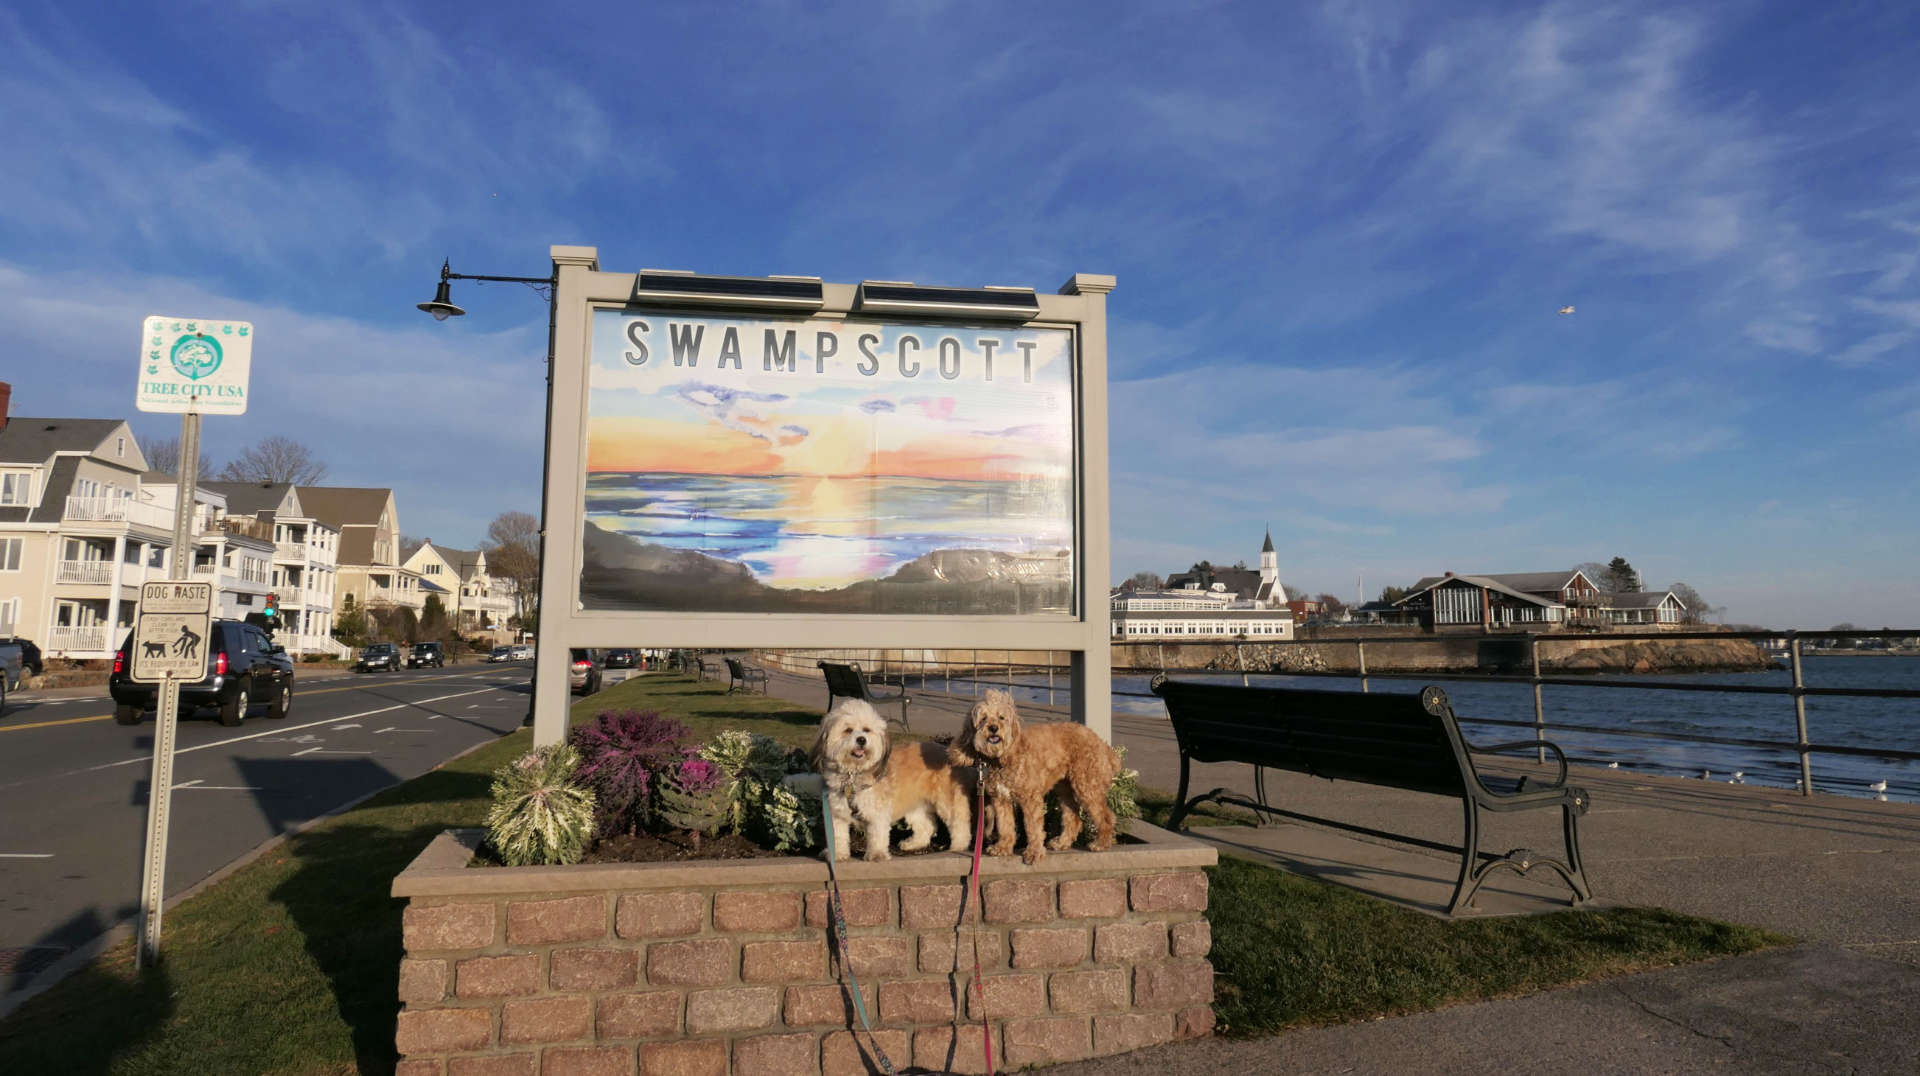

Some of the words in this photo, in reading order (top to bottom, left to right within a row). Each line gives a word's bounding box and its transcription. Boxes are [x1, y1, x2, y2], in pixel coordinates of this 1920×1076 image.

[625, 320, 1037, 383] SWAMPSCOTT
[142, 382, 179, 395] TREE
[182, 383, 214, 397] CITY
[217, 384, 244, 398] USA
[147, 586, 168, 599] DOG
[174, 586, 207, 600] WASTE
